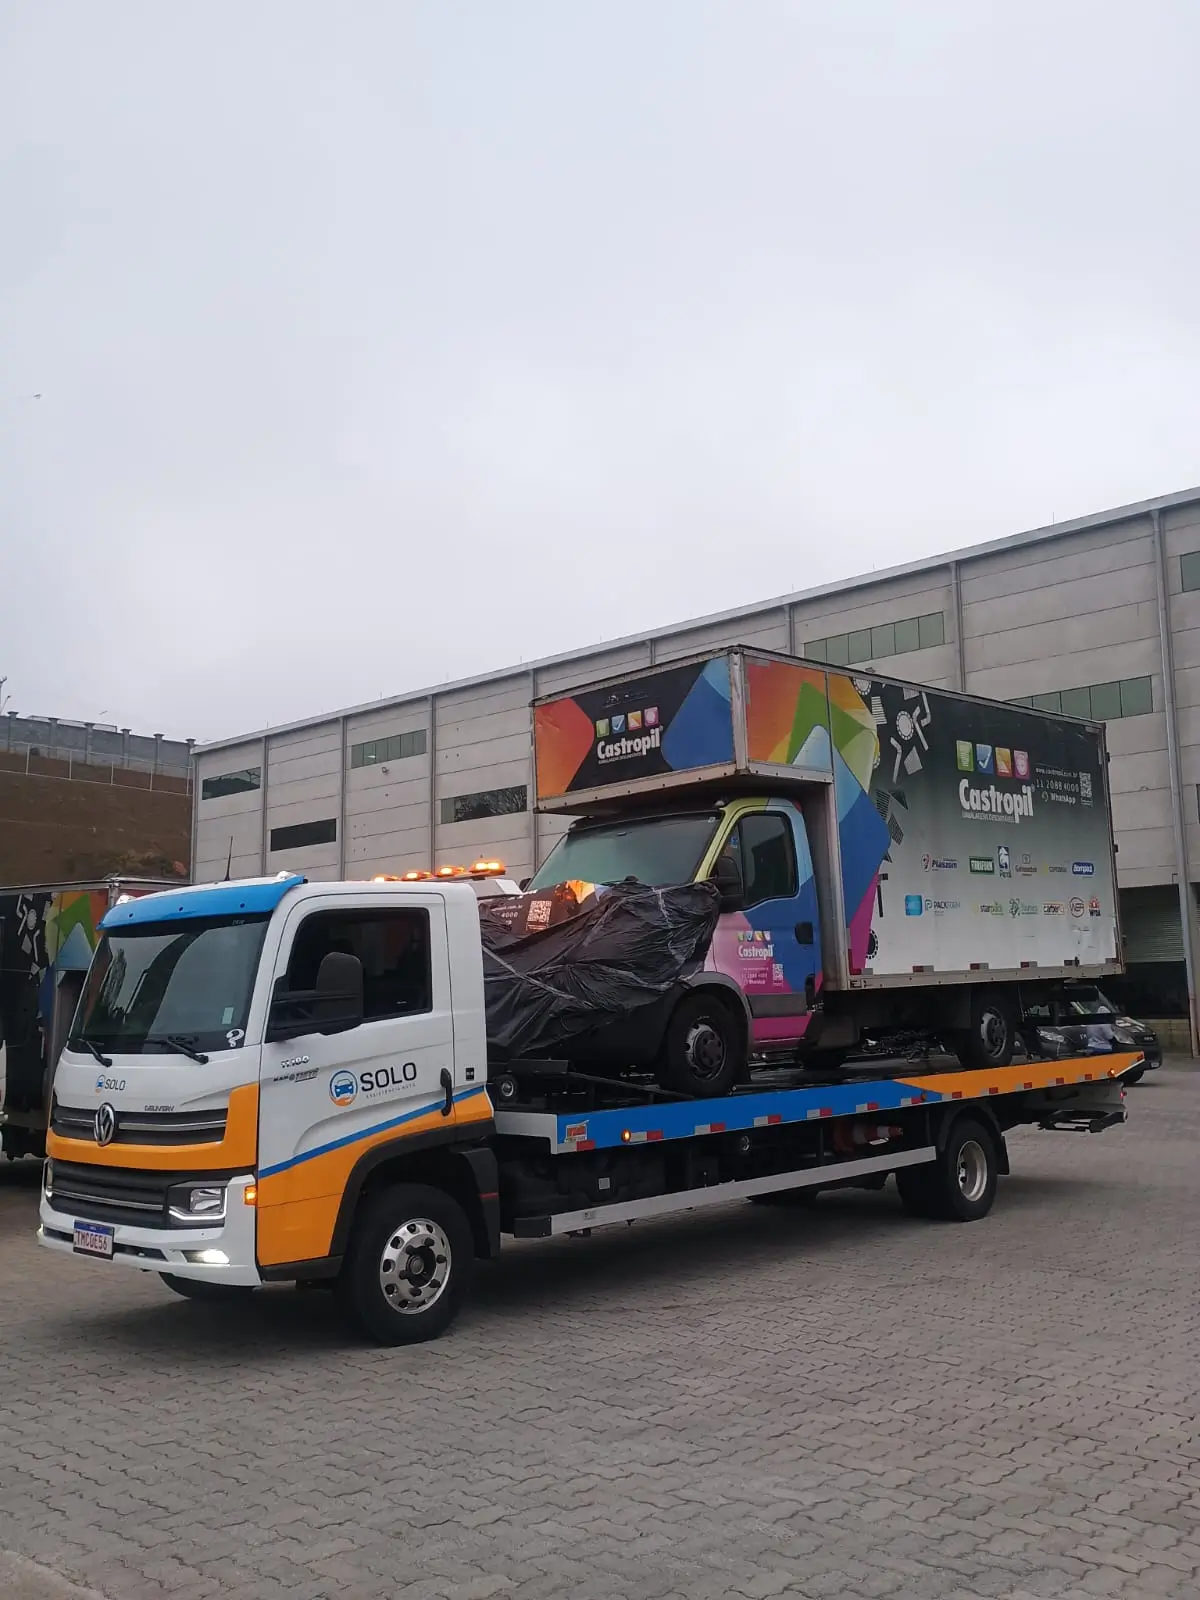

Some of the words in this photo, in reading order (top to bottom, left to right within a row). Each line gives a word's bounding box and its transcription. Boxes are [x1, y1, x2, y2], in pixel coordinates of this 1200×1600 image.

[597, 727, 660, 759] Castropil
[959, 778, 1034, 824] Castropil
[738, 944, 774, 960] Castropil
[104, 1078, 126, 1091] SOLO
[360, 1062, 417, 1092] SOLO
